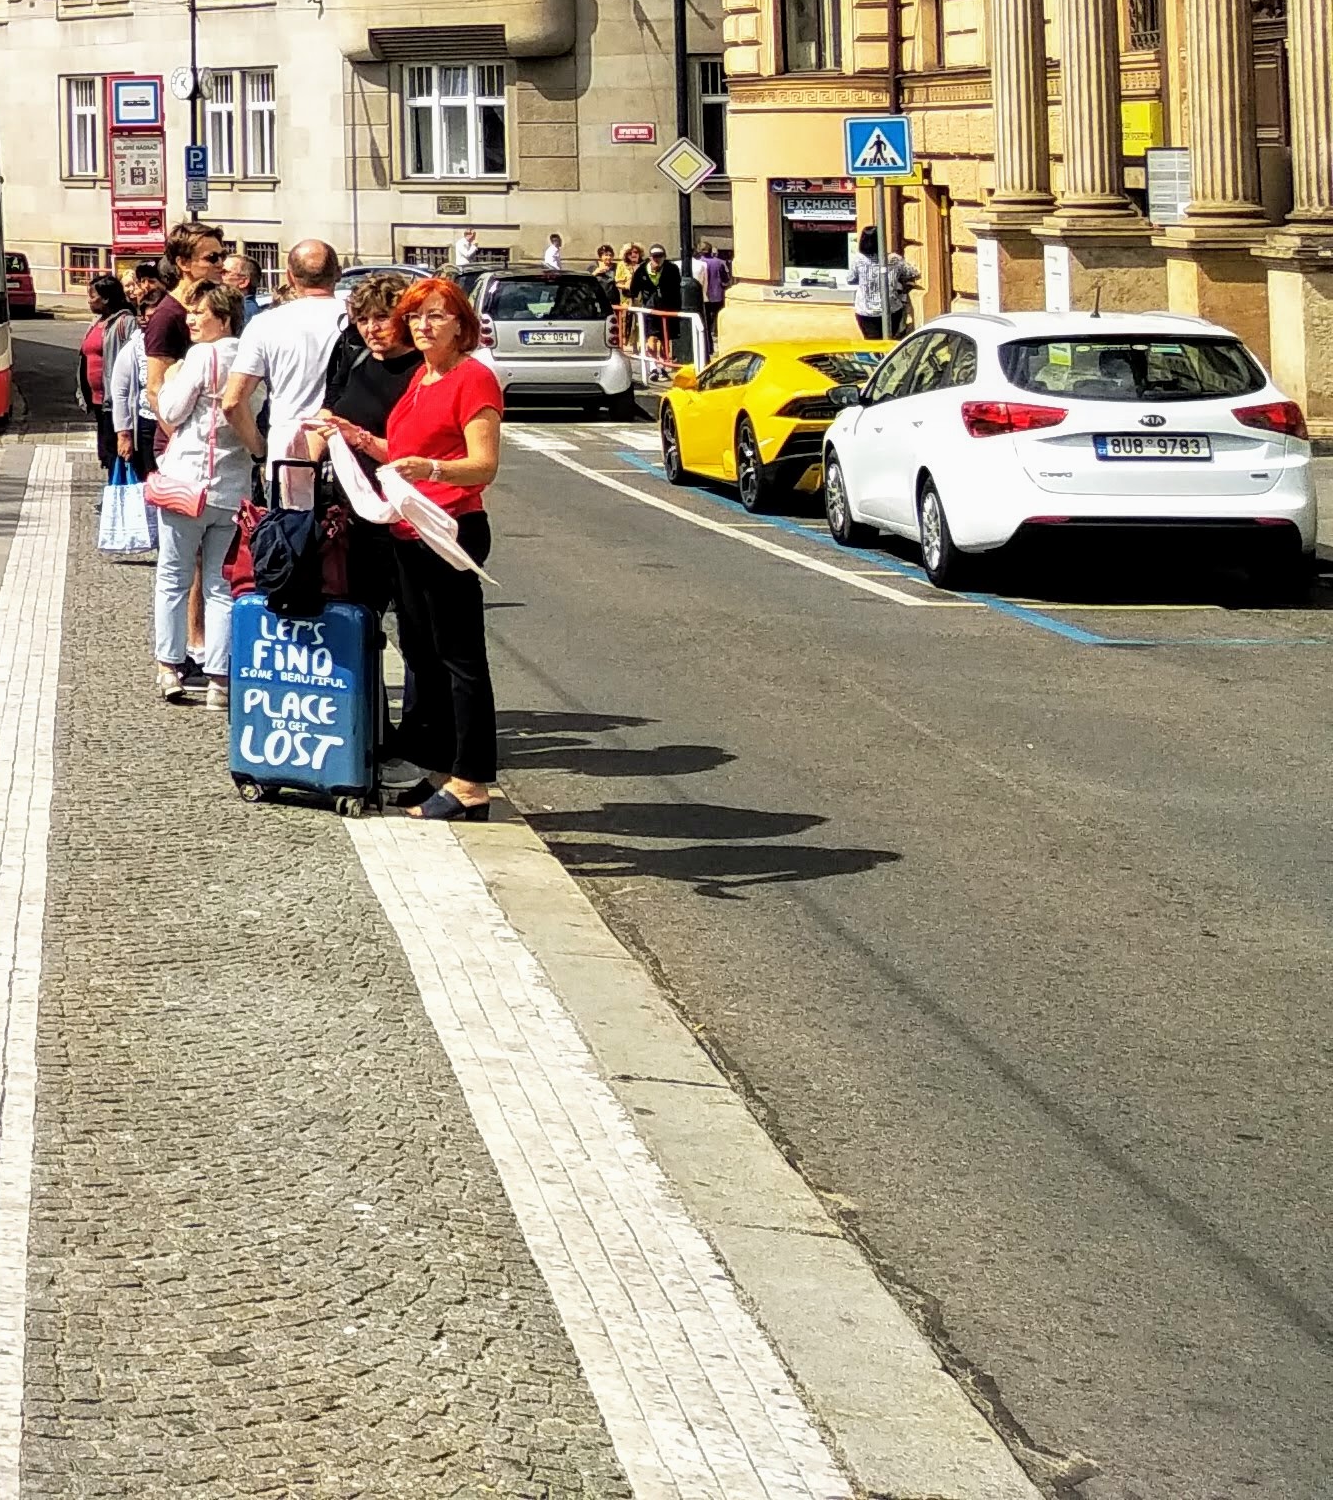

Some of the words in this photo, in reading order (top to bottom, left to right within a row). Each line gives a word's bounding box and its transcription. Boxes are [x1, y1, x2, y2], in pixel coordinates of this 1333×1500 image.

[787, 199, 856, 210] EXCHANGE
[1110, 438, 1144, 455] 8U8
[1157, 438, 1201, 455] 9783
[260, 615, 326, 645] LET'S
[240, 667, 273, 681] SOME
[280, 671, 348, 689] BEAUTIFUL
[244, 688, 338, 725] PLACE
[272, 719, 285, 730] TO
[288, 721, 309, 732] GET
[240, 725, 344, 770] LOST
